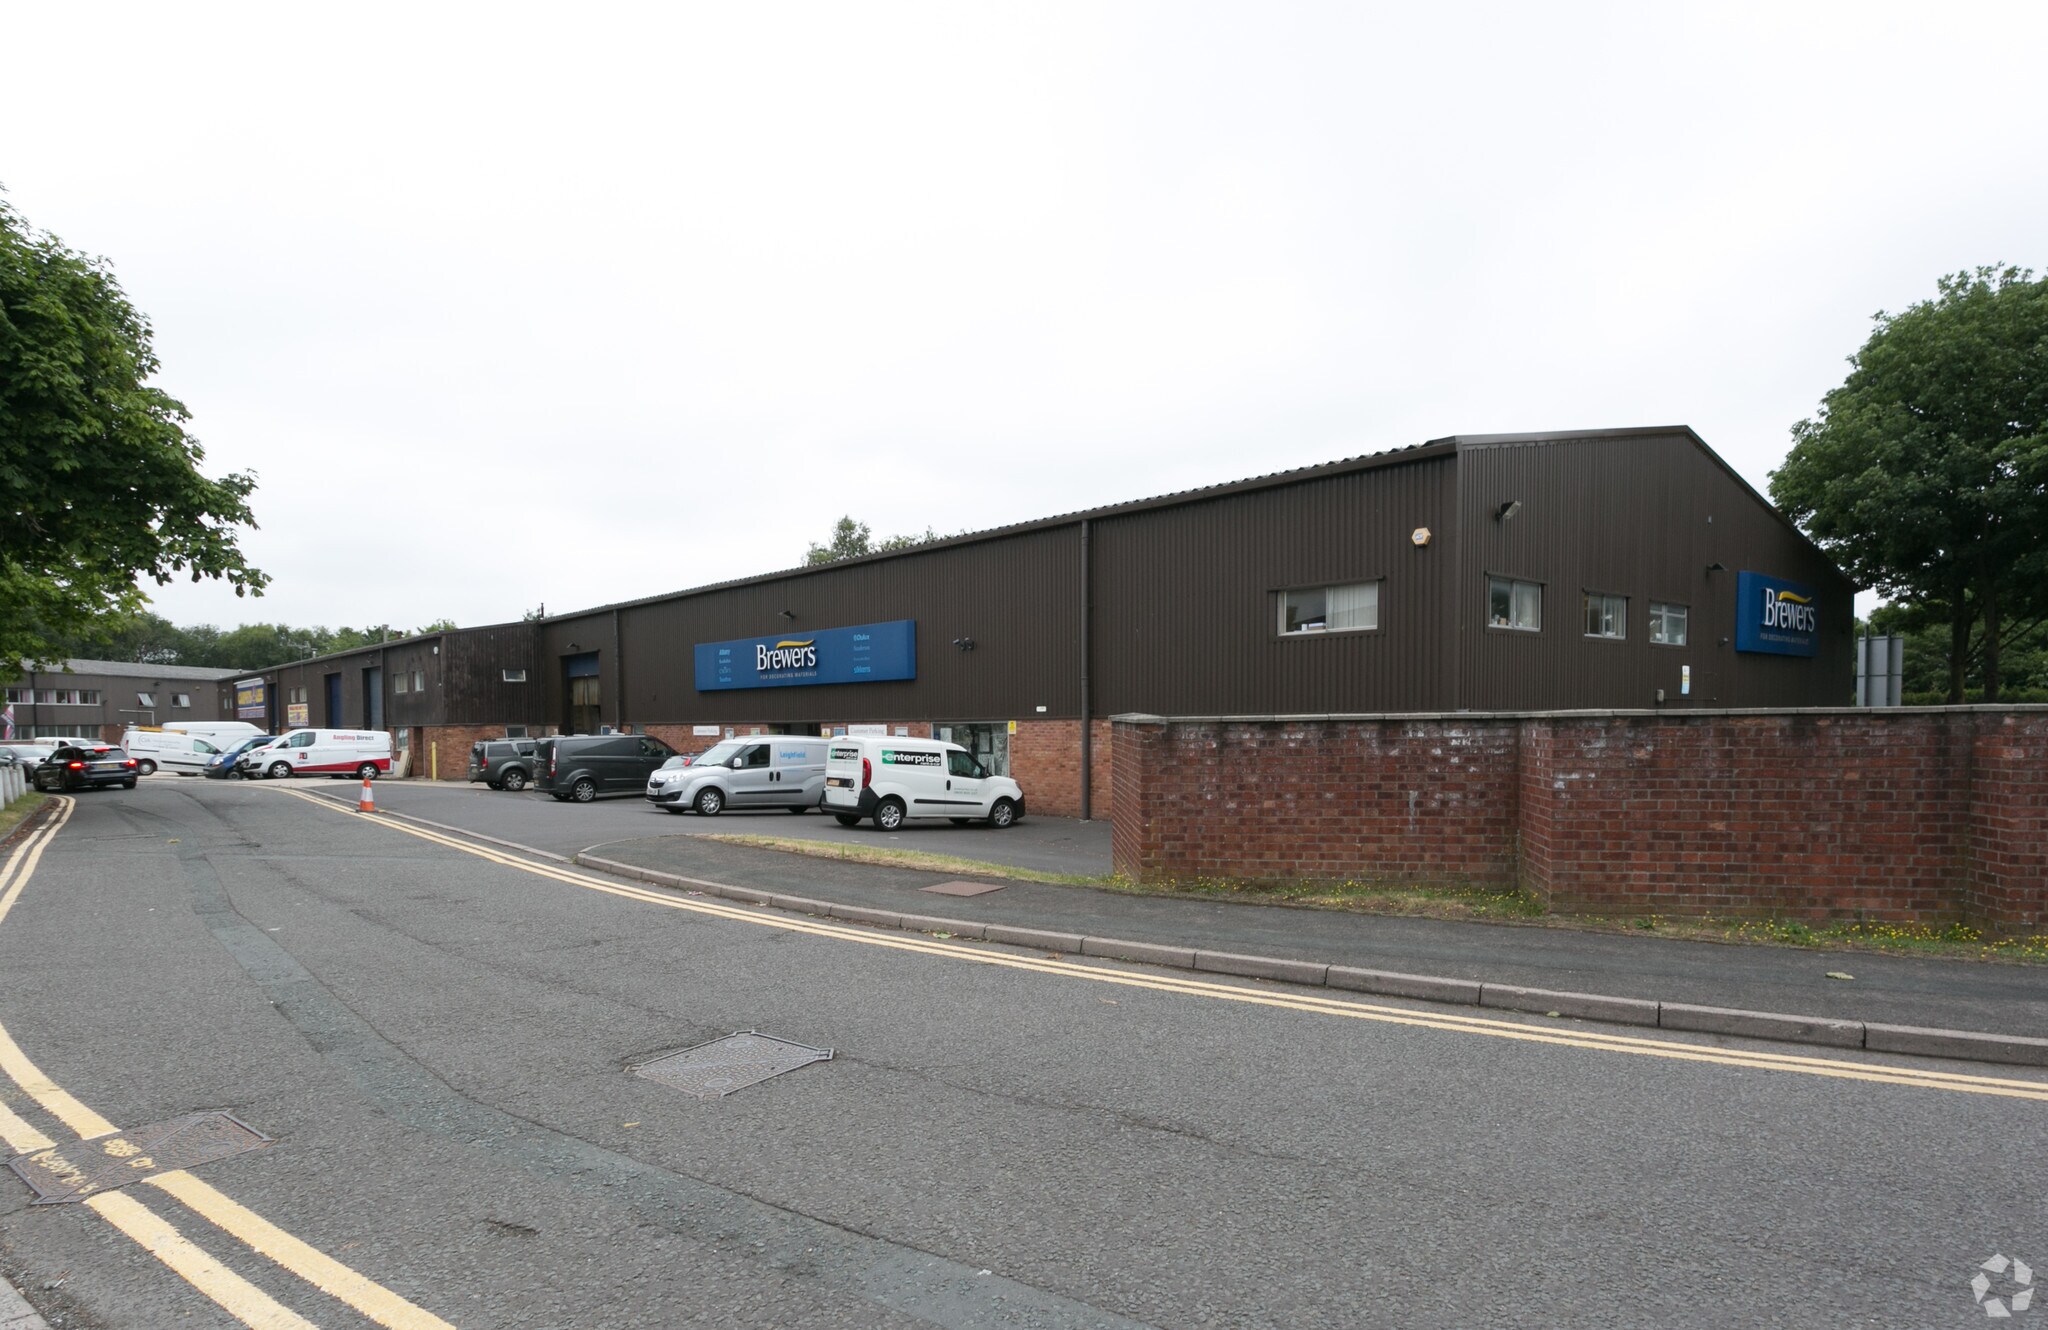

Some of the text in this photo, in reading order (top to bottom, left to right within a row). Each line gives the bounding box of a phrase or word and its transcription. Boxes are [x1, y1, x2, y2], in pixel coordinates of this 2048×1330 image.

[1764, 587, 1815, 632] Brewers
[756, 644, 816, 671] Brewers
[830, 749, 858, 758] enterprise
[883, 752, 940, 764] enterprise
